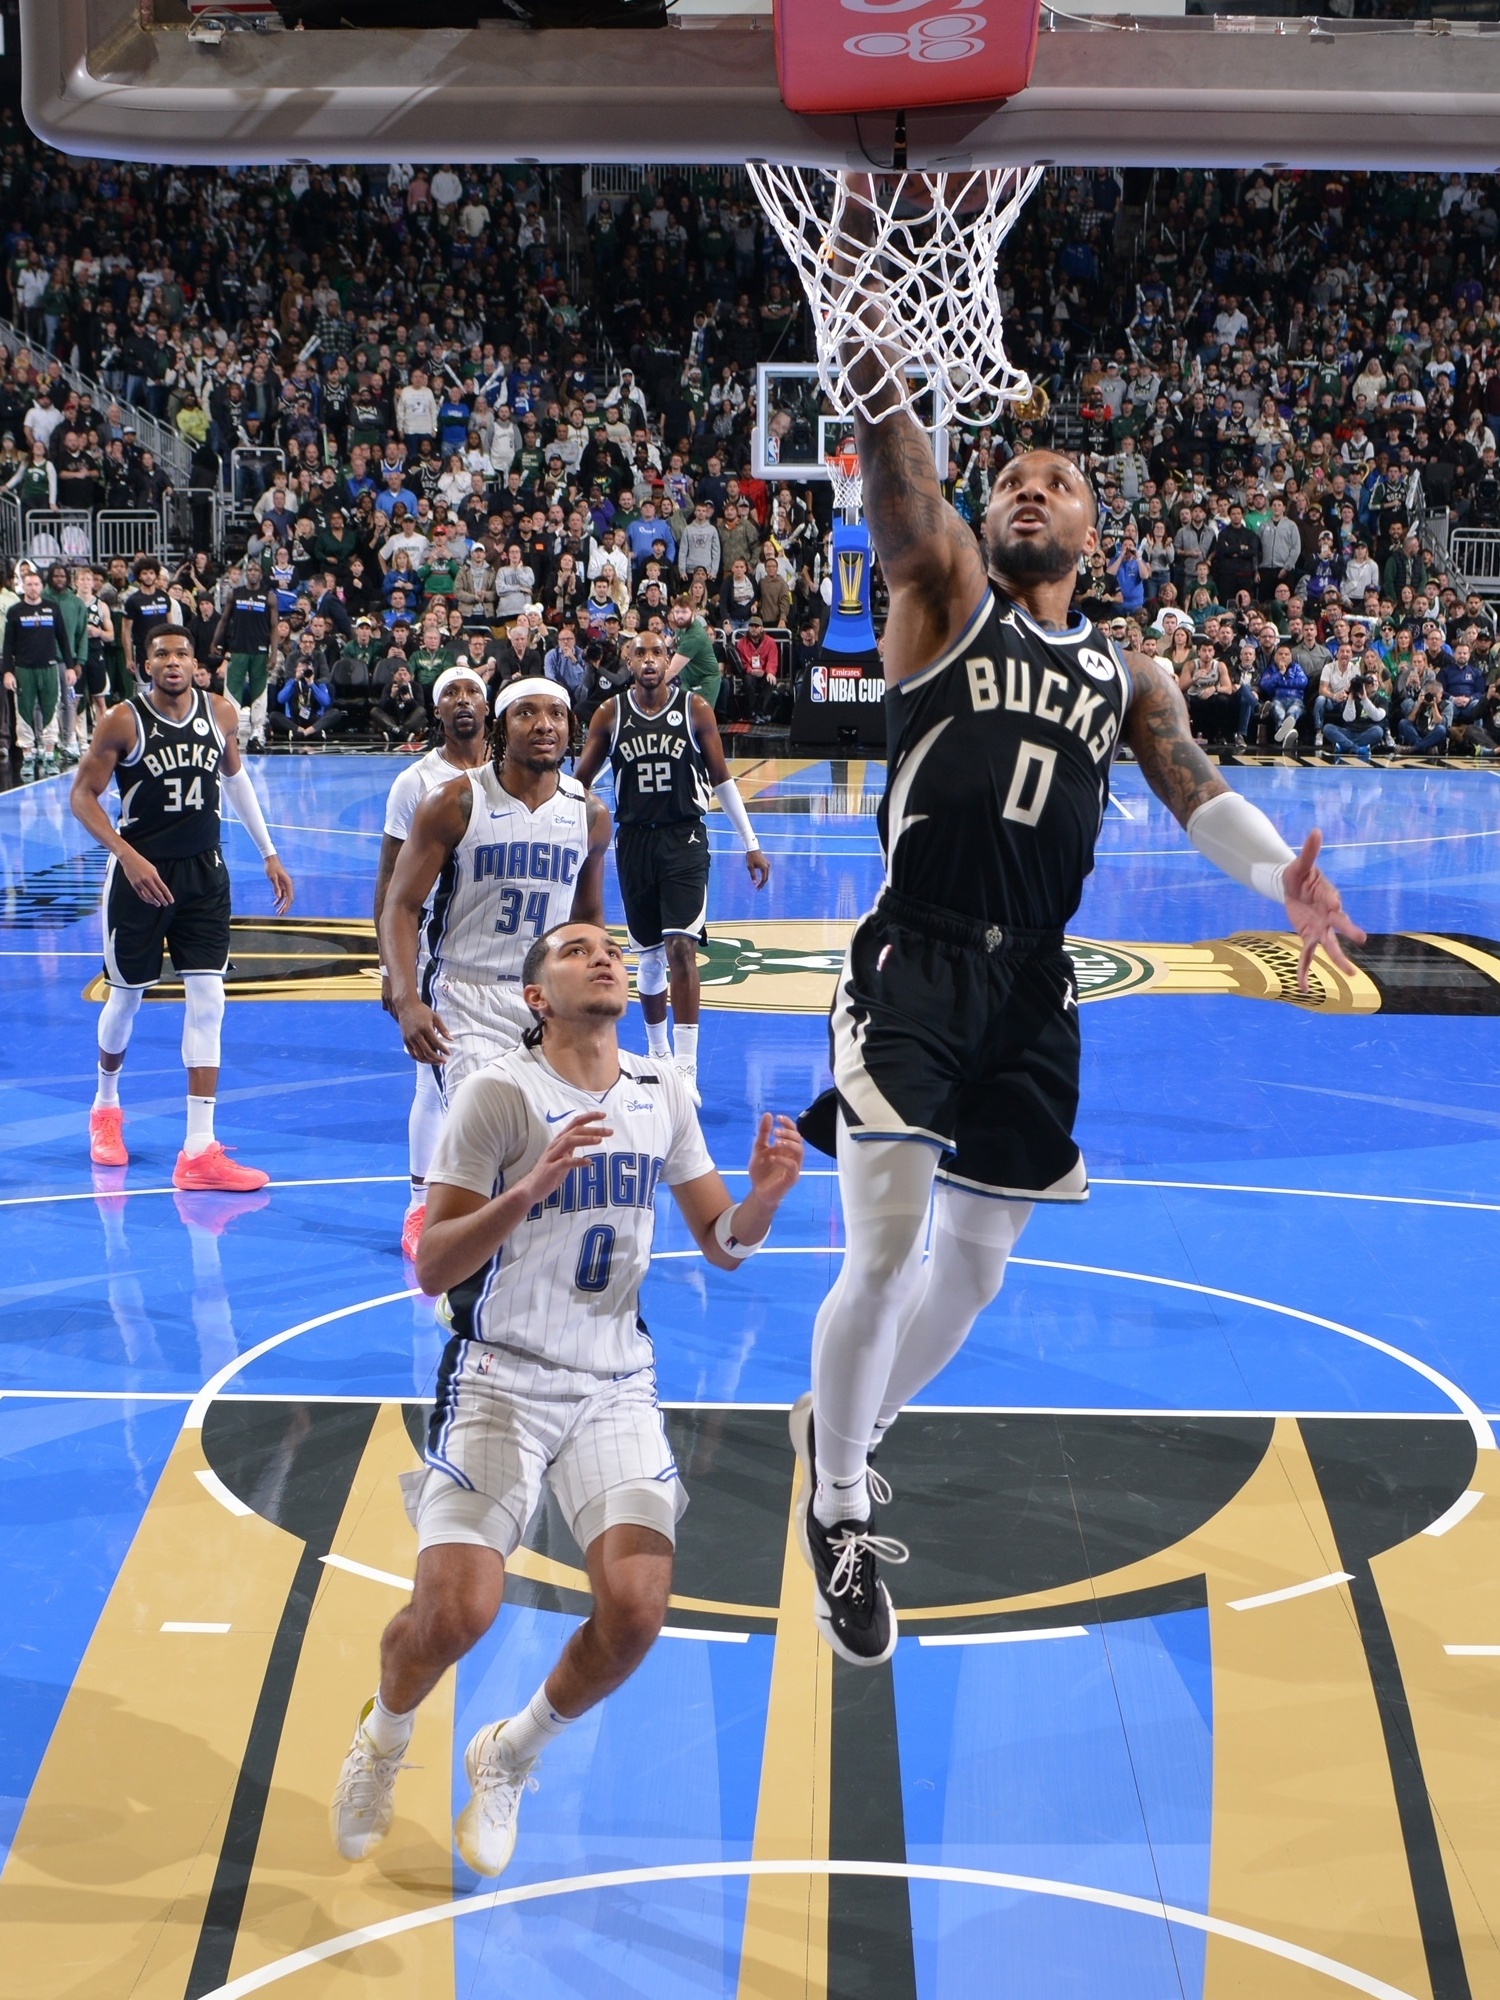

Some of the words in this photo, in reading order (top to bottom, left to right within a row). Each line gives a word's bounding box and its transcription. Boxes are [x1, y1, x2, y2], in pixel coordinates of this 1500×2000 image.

[831, 668, 861, 677] Emirates
[828, 678, 857, 702] NBA
[858, 678, 886, 703] CUP
[965, 656, 1118, 765] BUCKS
[143, 743, 219, 778] BUCKS
[619, 733, 687, 763] BUCKS
[163, 776, 204, 812] 34
[637, 762, 672, 793] 22
[1002, 739, 1058, 828] 0
[553, 813, 576, 828] Disney
[473, 841, 579, 886] MAGIC
[494, 888, 550, 938] 34
[624, 1099, 654, 1113] Disney
[575, 1223, 617, 1292] 0
